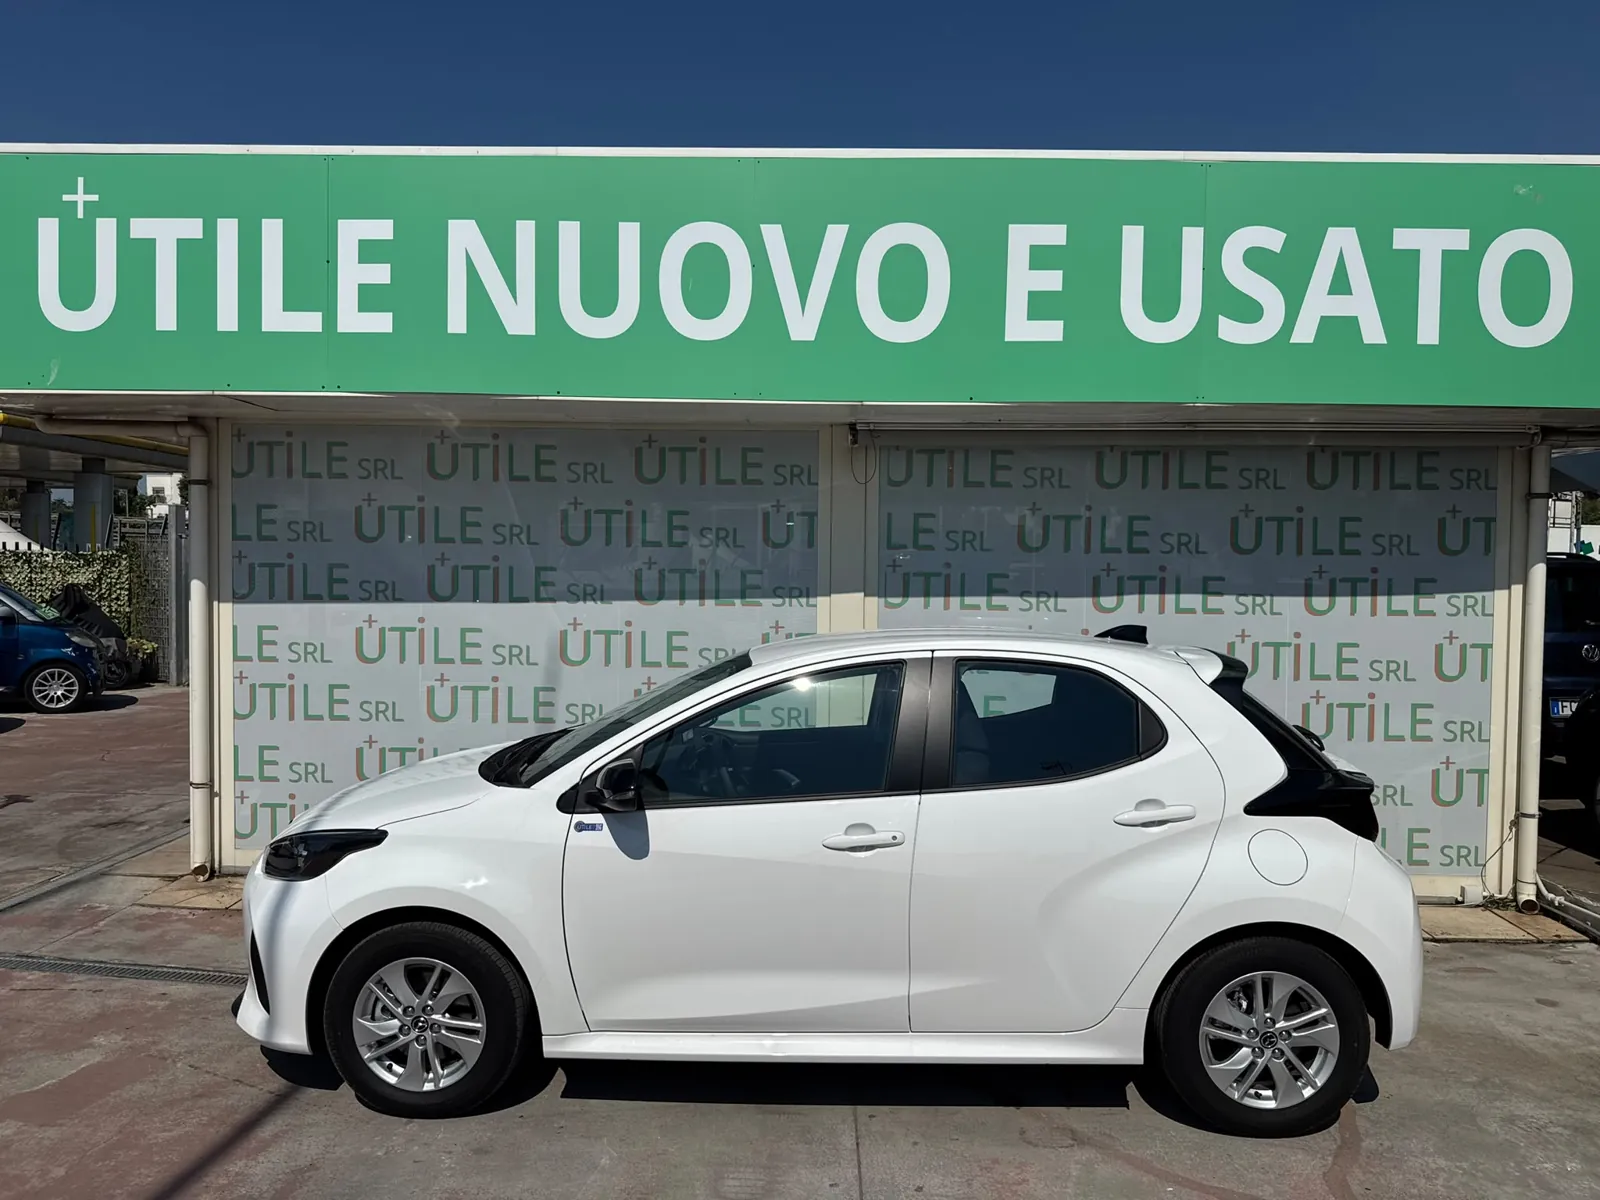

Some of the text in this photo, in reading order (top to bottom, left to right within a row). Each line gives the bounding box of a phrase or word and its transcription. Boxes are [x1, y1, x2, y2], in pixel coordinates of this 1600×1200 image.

[447, 219, 951, 343] NUOVO
[1004, 223, 1068, 342] E
[1119, 225, 1574, 348] USATO
[357, 458, 404, 480] SRL
[566, 462, 614, 484] SRL
[773, 464, 818, 486] SRL
[1022, 467, 1072, 489] SRL
[1238, 468, 1286, 490] SRL
[1450, 468, 1497, 491] SRL
[286, 521, 333, 543] SRL
[492, 523, 540, 545] SRL
[699, 527, 746, 549] SRL
[944, 530, 993, 552] SRL
[1159, 532, 1208, 555] SRL
[1371, 534, 1420, 556] SRL
[358, 580, 404, 602] SRL
[566, 583, 613, 604] SRL
[771, 587, 818, 607] SRL
[1018, 591, 1067, 613] SRL
[1234, 594, 1283, 616] SRL
[1446, 595, 1494, 617] SRL
[287, 642, 333, 663] SRL
[491, 644, 539, 666] SRL
[698, 647, 736, 668] SR
[1368, 660, 1417, 682] SRL
[358, 701, 405, 722] SRL
[1442, 721, 1490, 742] SRL
[288, 762, 334, 783] SRL
[1440, 845, 1486, 867] SRL
